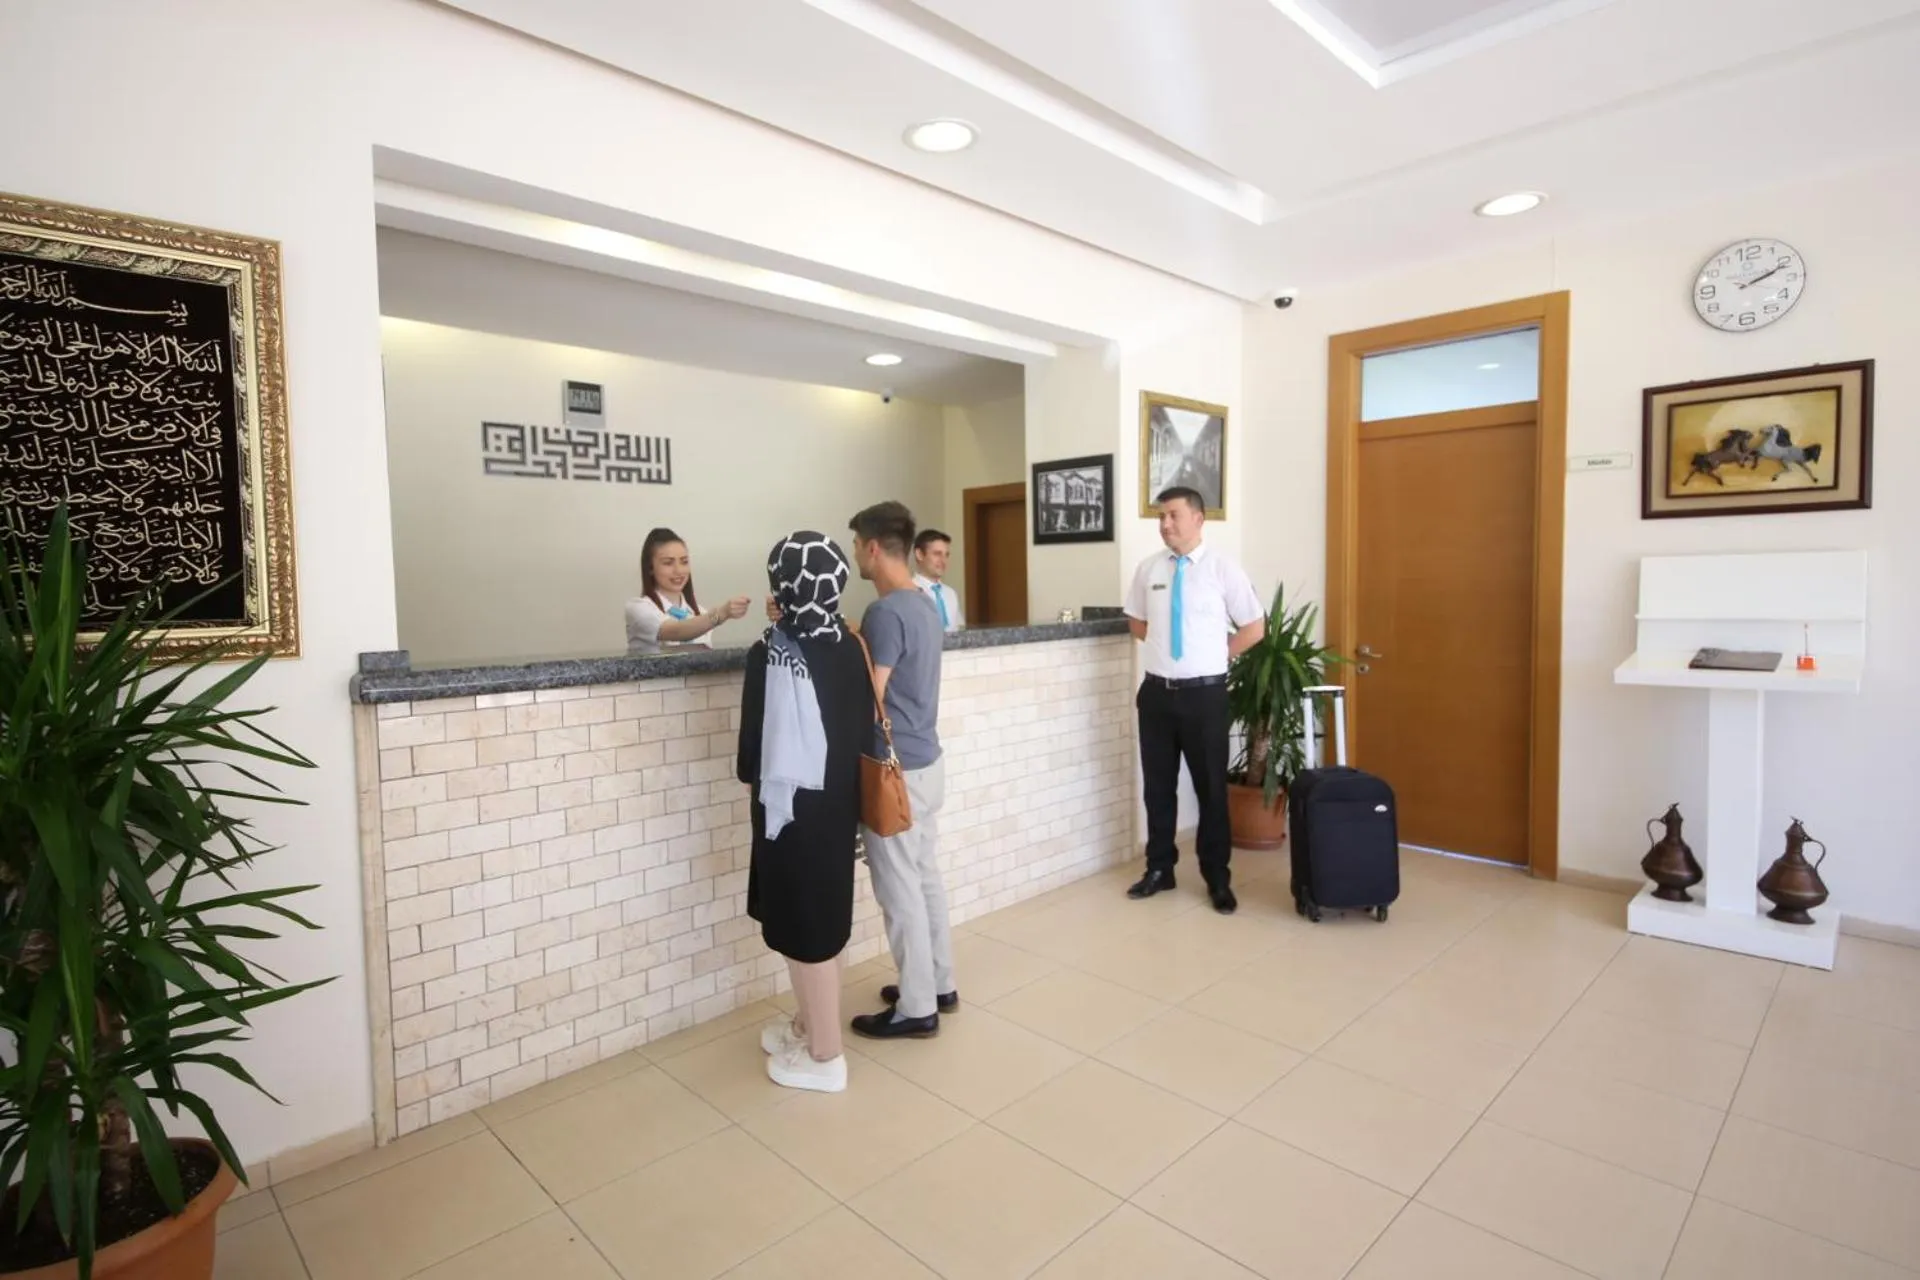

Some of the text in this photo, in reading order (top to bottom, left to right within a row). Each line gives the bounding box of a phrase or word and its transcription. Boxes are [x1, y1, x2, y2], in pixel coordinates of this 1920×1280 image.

[1735, 245, 1762, 262] 12
[1717, 257, 1731, 266] 11
[1776, 255, 1792, 268] 2
[1699, 285, 1716, 300] 9
[1778, 288, 1789, 299] 4
[1707, 302, 1720, 313] 8
[1763, 304, 1780, 314] 5
[1738, 311, 1756, 326] 6
